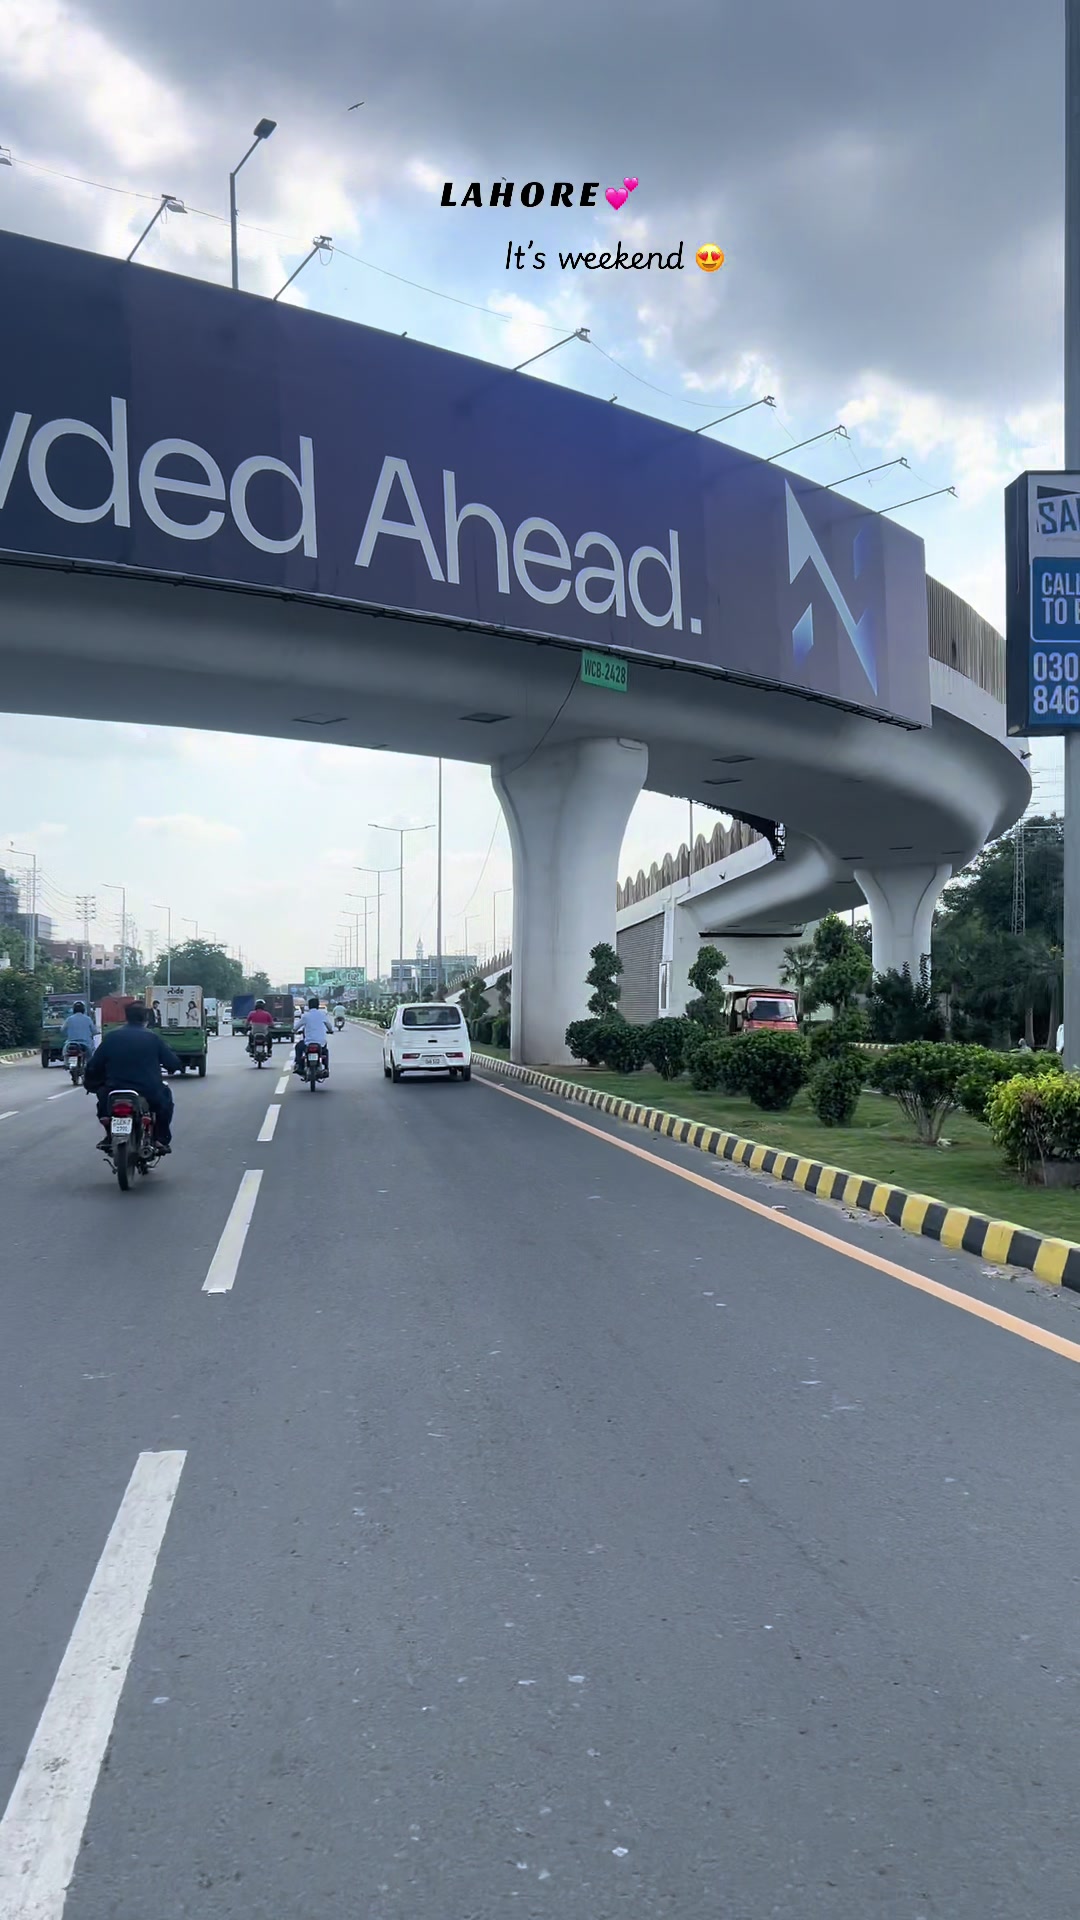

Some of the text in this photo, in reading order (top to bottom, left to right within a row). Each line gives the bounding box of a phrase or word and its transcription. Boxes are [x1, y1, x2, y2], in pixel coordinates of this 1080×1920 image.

[1039, 499, 1080, 534] SA
[355, 455, 702, 634] Ahead.
[1041, 597, 1067, 624] TO
[584, 659, 626, 684] WCB-2428
[1033, 652, 1079, 682] 030
[1033, 685, 1079, 714] 846
